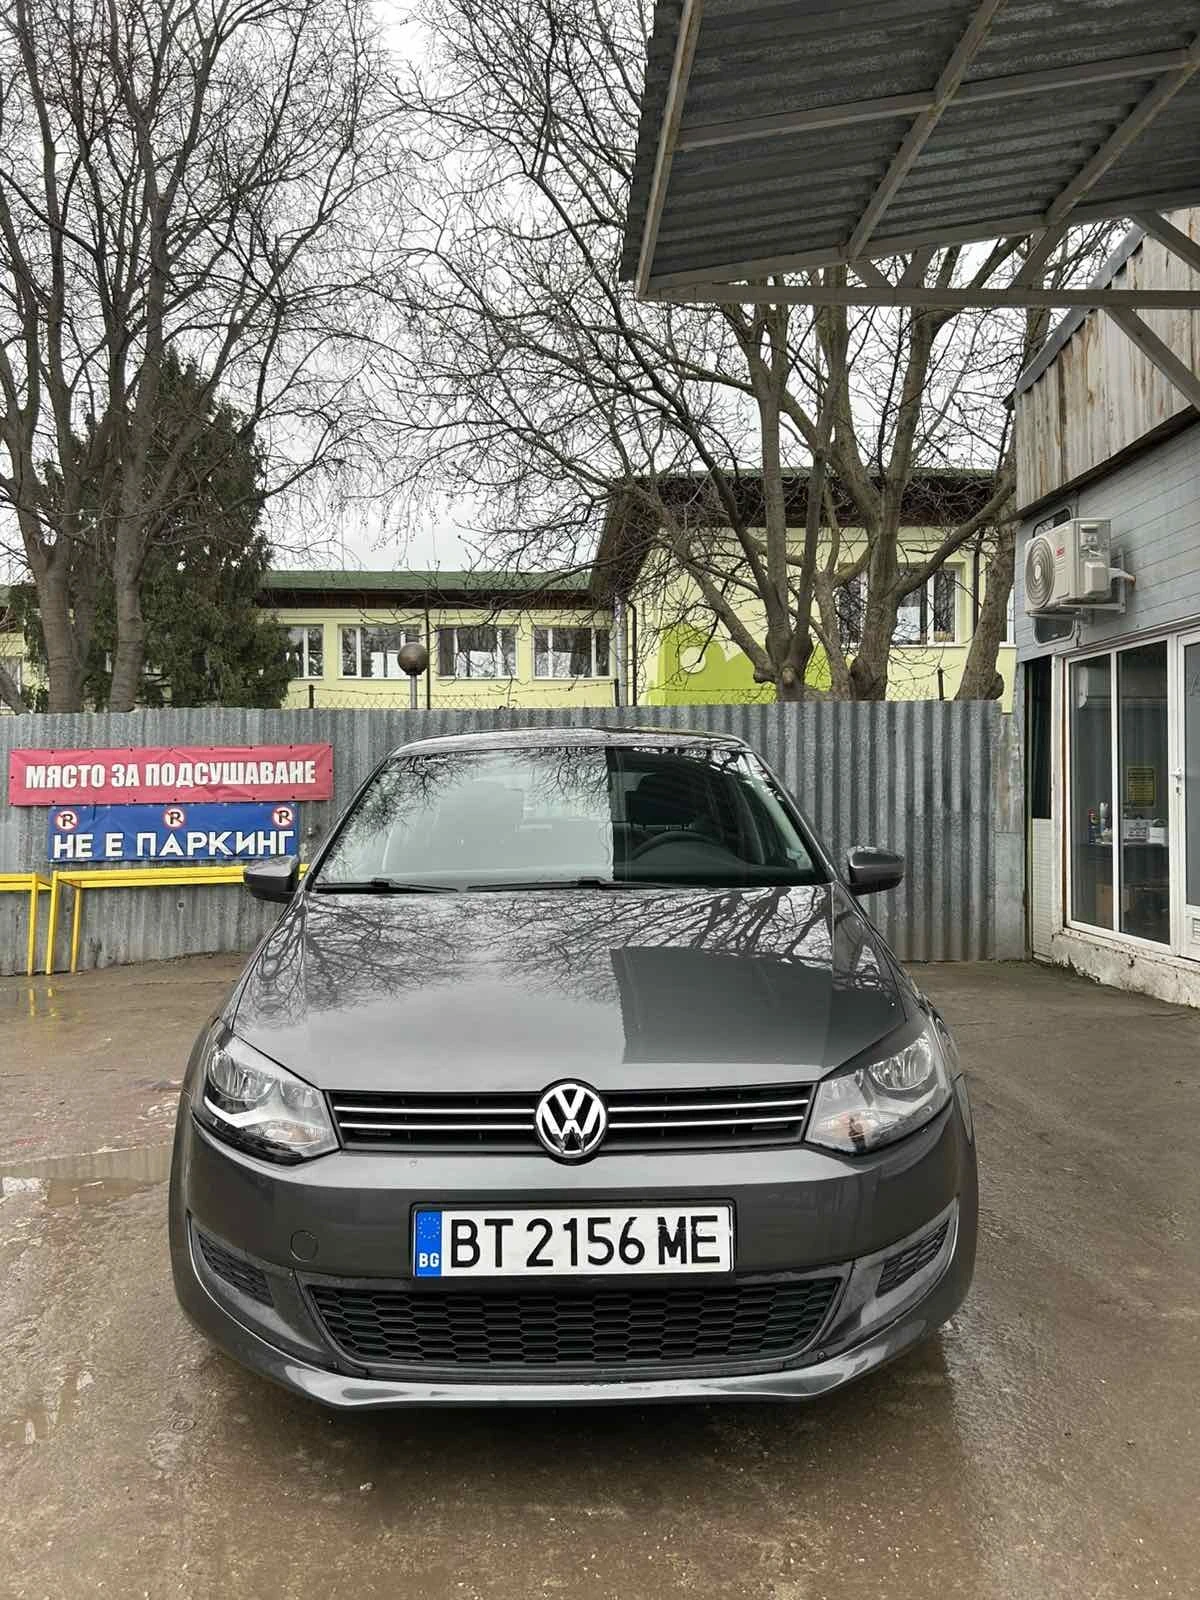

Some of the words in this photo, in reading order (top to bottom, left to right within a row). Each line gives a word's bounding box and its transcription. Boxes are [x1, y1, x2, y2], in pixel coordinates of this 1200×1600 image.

[25, 764, 105, 789] МЯСТО
[111, 763, 140, 787] ЗА
[145, 760, 317, 788] ПОДСУШАВАНЕ
[53, 833, 93, 859] НЕ
[105, 832, 124, 858] Е
[136, 830, 295, 857] ПАРКИНГ
[418, 1252, 440, 1268] BG
[450, 1218, 514, 1268] BT
[526, 1216, 645, 1267] 2156
[657, 1215, 721, 1265] ME
